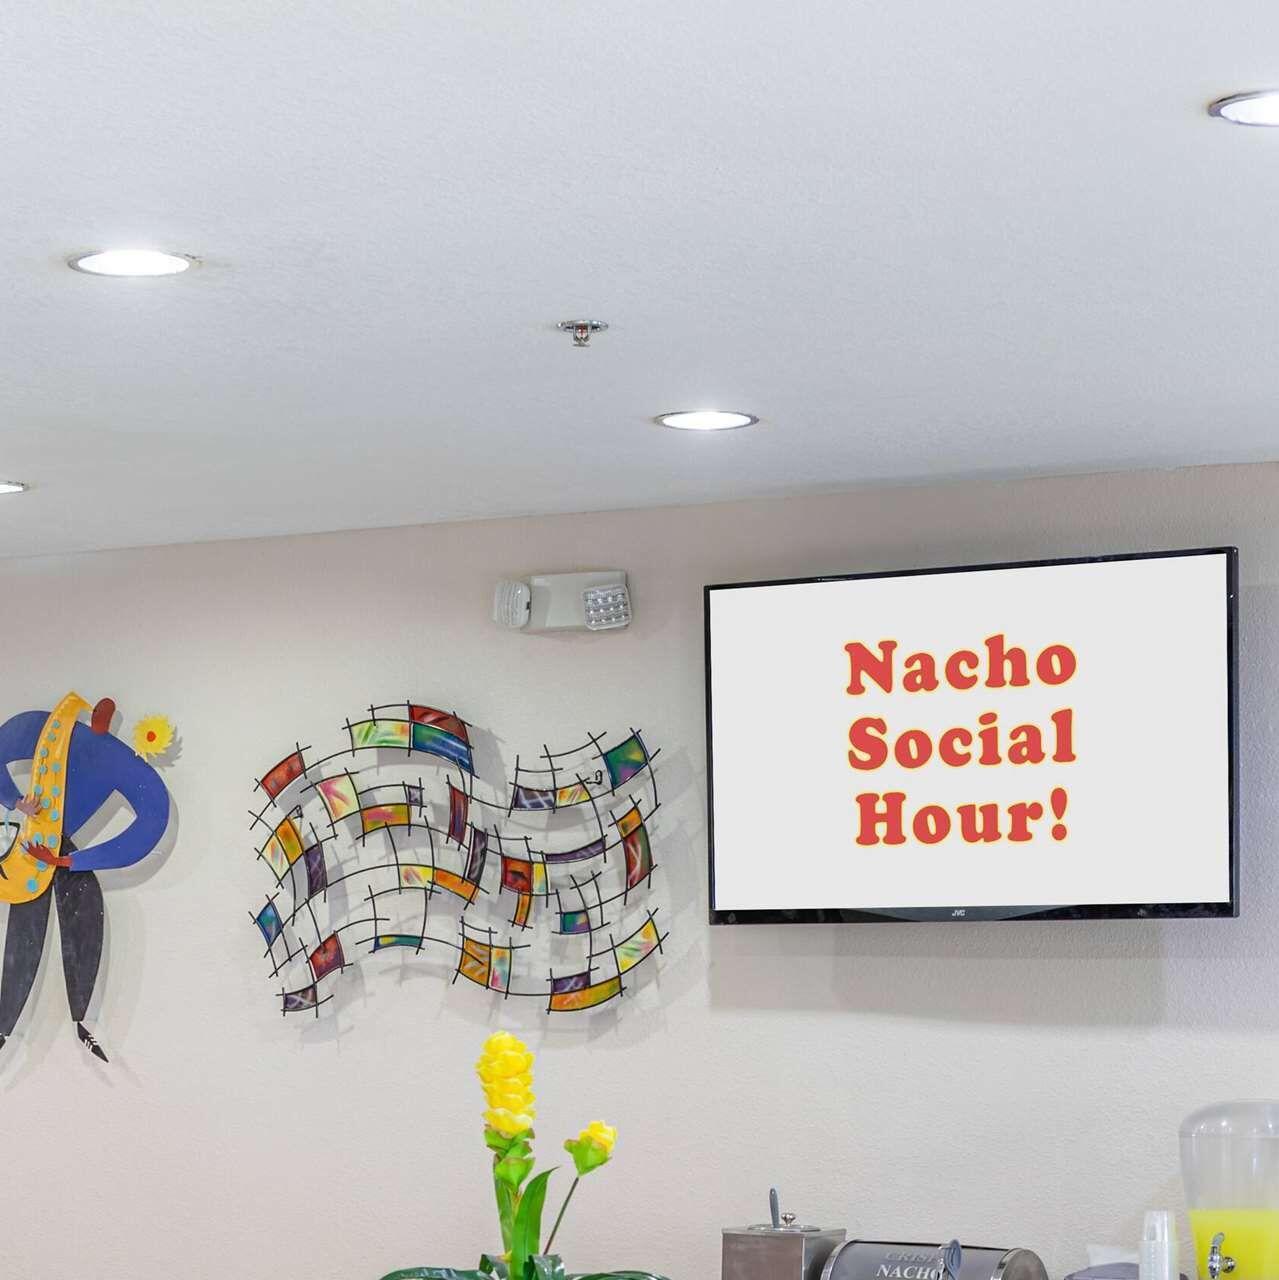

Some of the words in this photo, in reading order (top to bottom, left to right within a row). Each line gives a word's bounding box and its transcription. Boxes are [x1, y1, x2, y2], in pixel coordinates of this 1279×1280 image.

[844, 633, 1077, 696] Nacho
[847, 708, 1077, 771] Social
[855, 787, 1068, 846] Hour!
